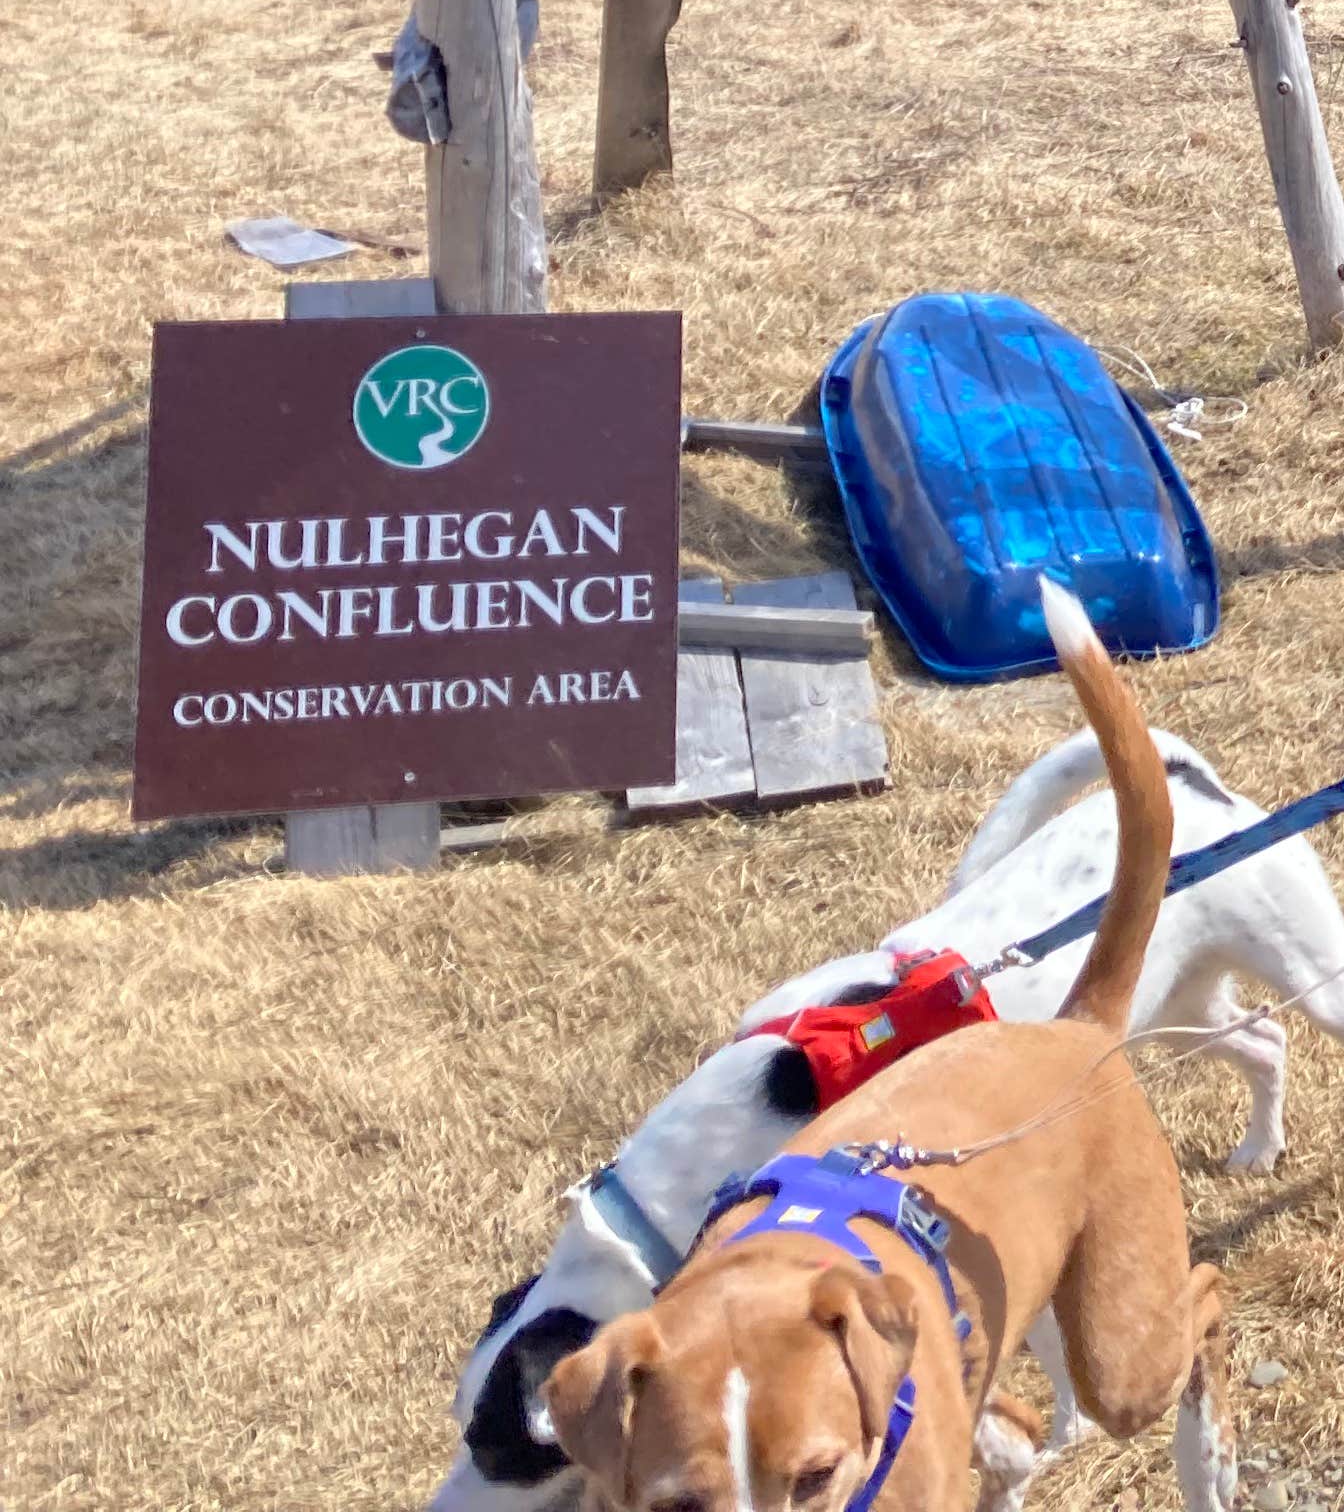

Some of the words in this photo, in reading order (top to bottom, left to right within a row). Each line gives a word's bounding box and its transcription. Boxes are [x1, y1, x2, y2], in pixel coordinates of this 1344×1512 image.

[360, 375, 481, 419] VRC
[202, 505, 627, 574] NULHEGAN
[164, 573, 656, 648] CONFLUENCE
[172, 675, 511, 728] CONSERVATION
[526, 668, 642, 705] AREA
